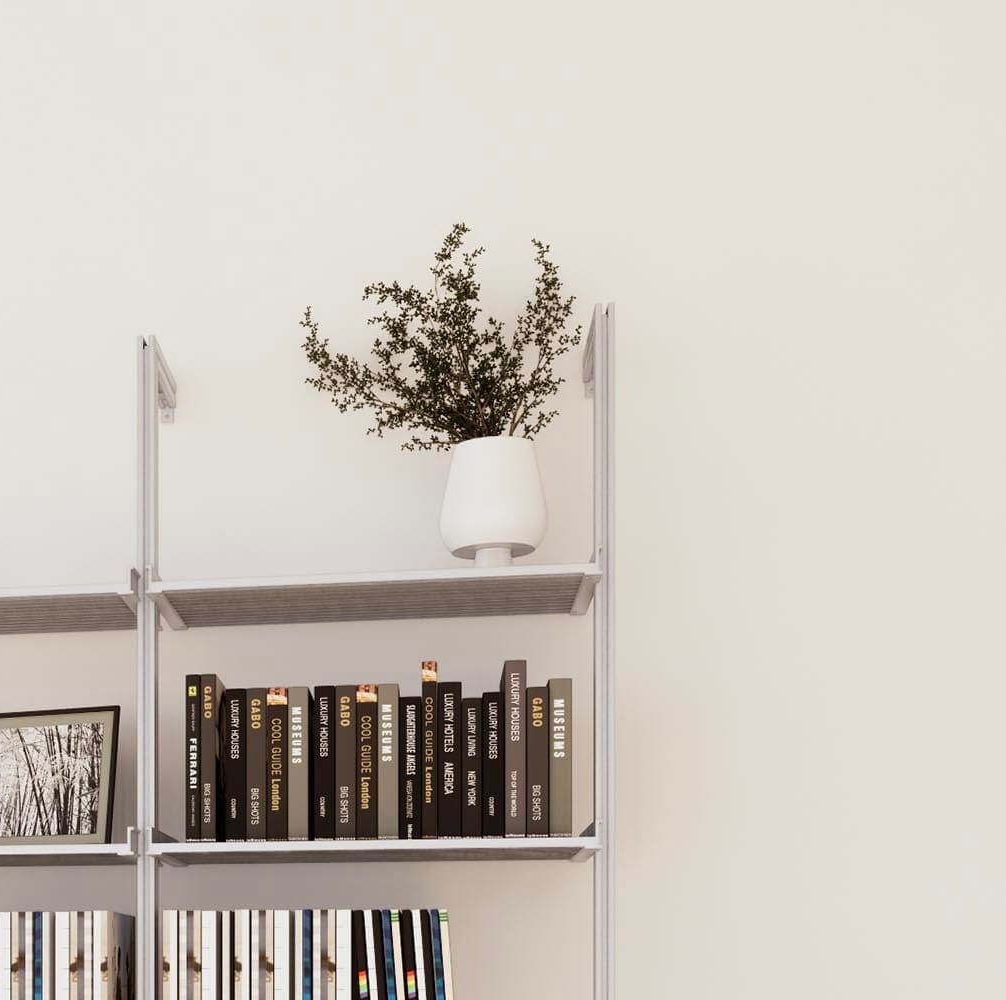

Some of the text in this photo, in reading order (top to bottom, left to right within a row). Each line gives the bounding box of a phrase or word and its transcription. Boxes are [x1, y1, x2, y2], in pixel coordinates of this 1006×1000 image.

[204, 686, 212, 719] GABO
[231, 700, 239, 759] LUXURY HOUSES
[251, 699, 261, 729] GABO
[320, 697, 328, 757] LUXURY HOUSES
[341, 696, 350, 727] GABO
[406, 704, 415, 753] SLAUGHTERHOUSE
[511, 673, 520, 741] LUXURY HOUSES
[532, 698, 543, 727] GABO
[553, 699, 565, 758] MUSEUMS
[292, 707, 302, 764] MUSEUMS
[382, 704, 392, 762] MUSEUMS
[425, 697, 434, 803] COOL GUIDE London
[444, 693, 454, 795] LUXURY HOTELS AMERICA
[467, 708, 476, 806] LUXURY LIVING NEW YORK
[488, 703, 498, 759] LUXURY HOUSES
[189, 738, 197, 789] FERRARI
[271, 718, 282, 811] COOL GUIDE London
[361, 716, 371, 810] COOL GUIDE London
[406, 754, 415, 775] ANGELS
[251, 788, 259, 825] BIG SHOTS
[340, 786, 349, 823] BIG SHOTS
[532, 785, 541, 820] BIG SHOTS
